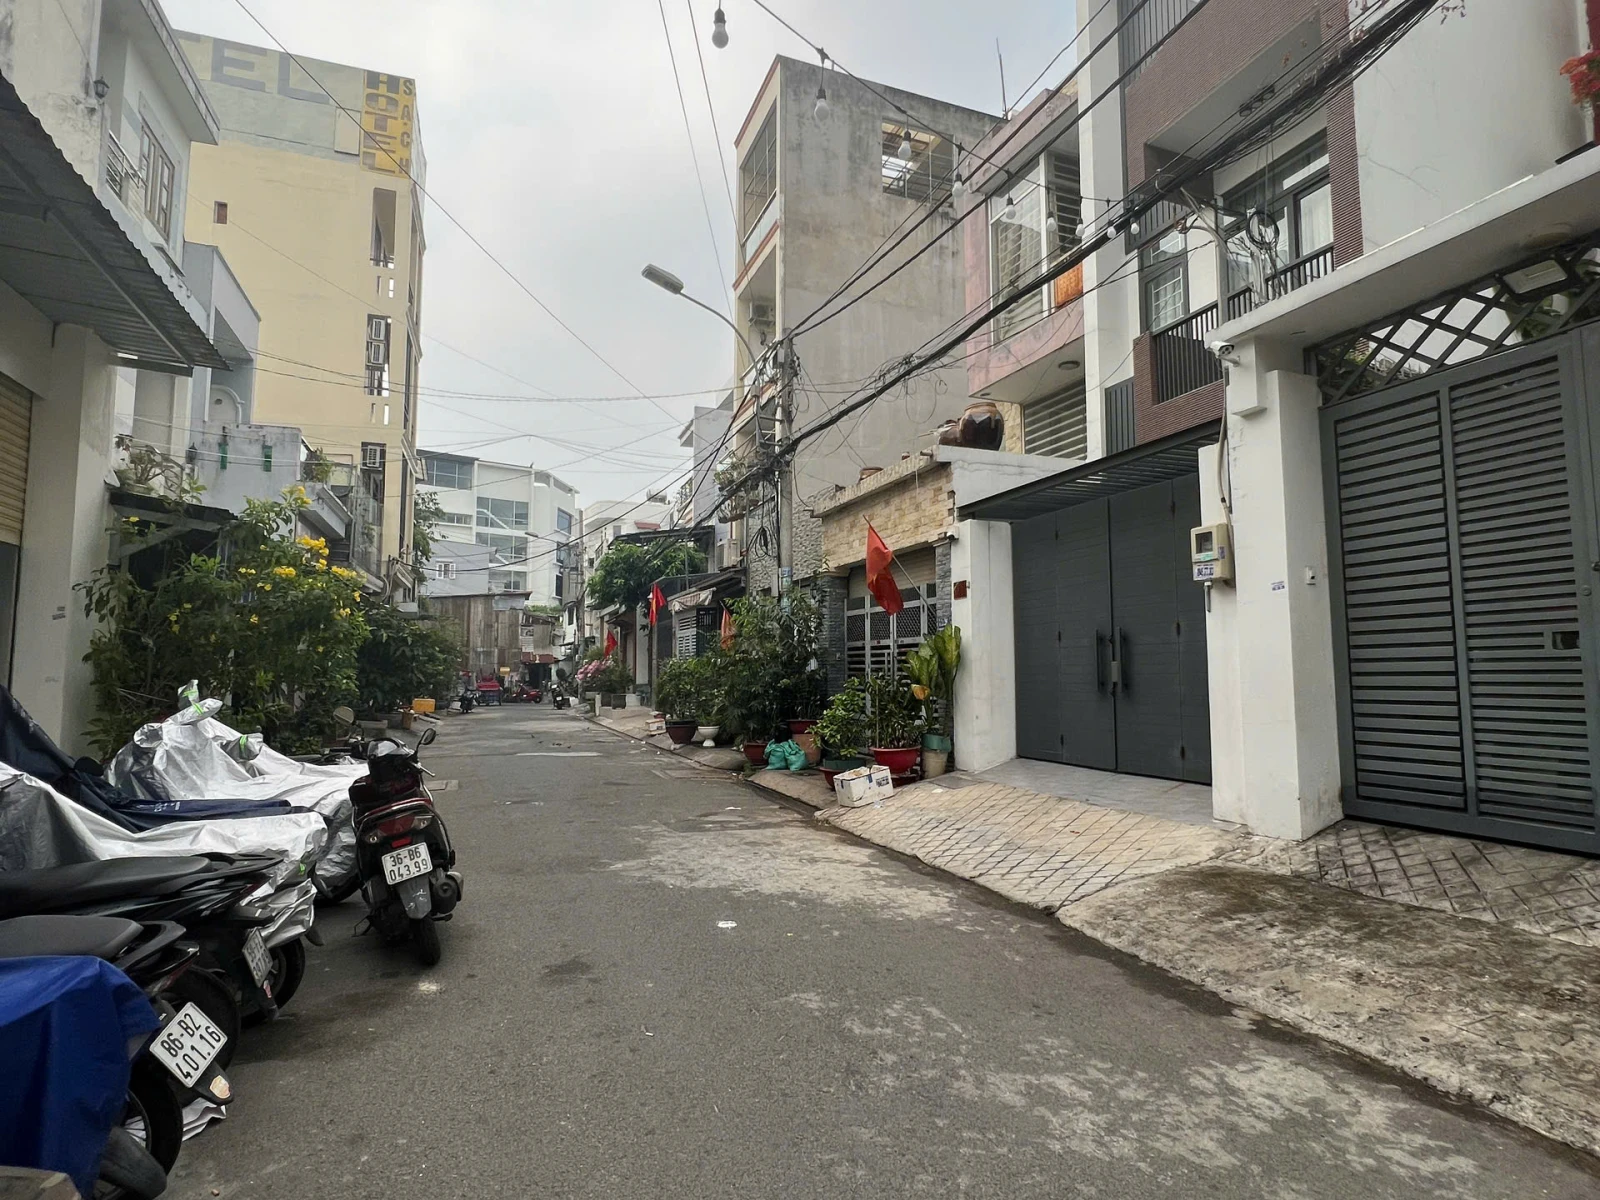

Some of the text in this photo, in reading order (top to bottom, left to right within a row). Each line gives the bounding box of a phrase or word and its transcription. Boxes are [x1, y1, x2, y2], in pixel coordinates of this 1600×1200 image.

[172, 28, 330, 105] EL
[362, 71, 399, 174] HOTEL
[389, 847, 422, 868] 36-B6
[389, 858, 429, 882] 043.99
[160, 1012, 202, 1058] 86-B2
[176, 1025, 222, 1080] 401.16
